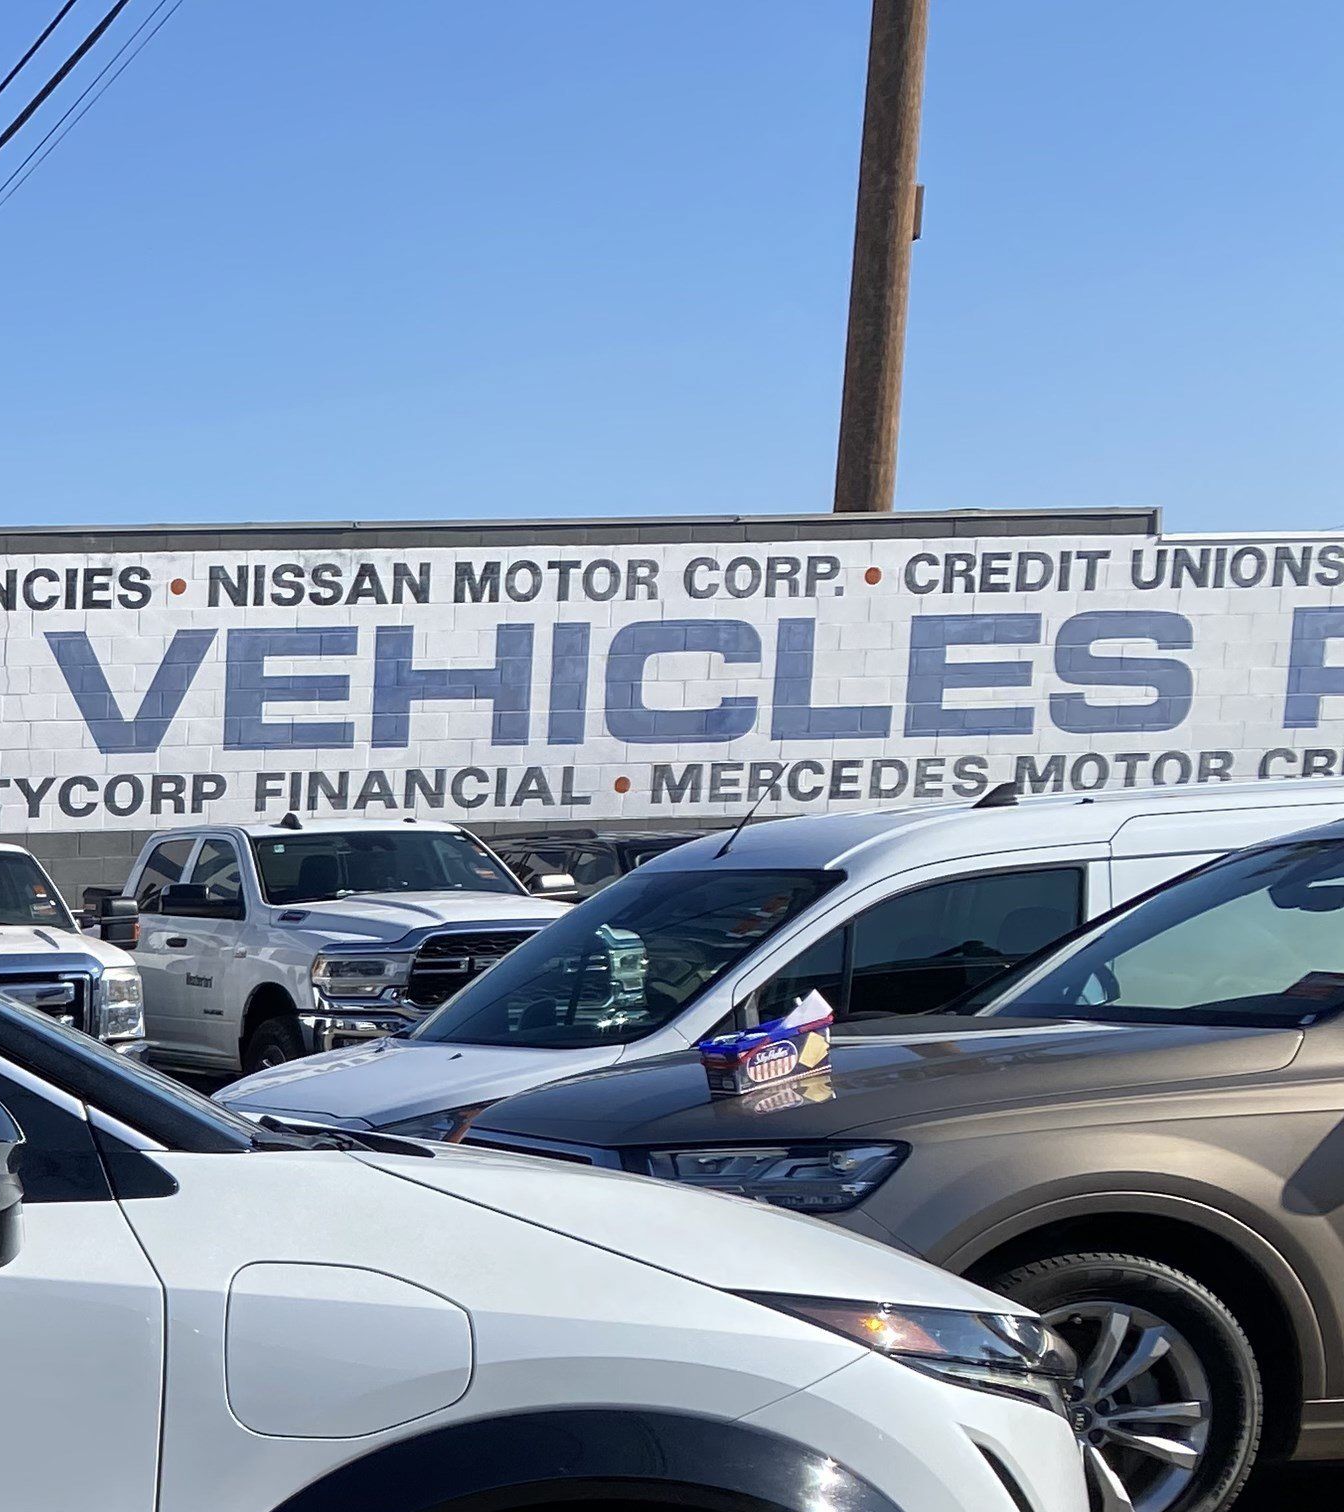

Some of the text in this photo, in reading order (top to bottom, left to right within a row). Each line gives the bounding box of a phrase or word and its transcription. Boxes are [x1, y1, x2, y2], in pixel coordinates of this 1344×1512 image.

[207, 562, 431, 608] NISSAN
[453, 559, 659, 604] MOTOR
[683, 555, 845, 599] CORP.
[904, 550, 1112, 595] CREDIT
[1131, 545, 1344, 590] UNIONS
[43, 609, 1194, 755] VEHICLES
[254, 766, 592, 812] FINANCIAL
[650, 756, 990, 806] MERCEDES
[1015, 751, 1234, 794] MOTOR
